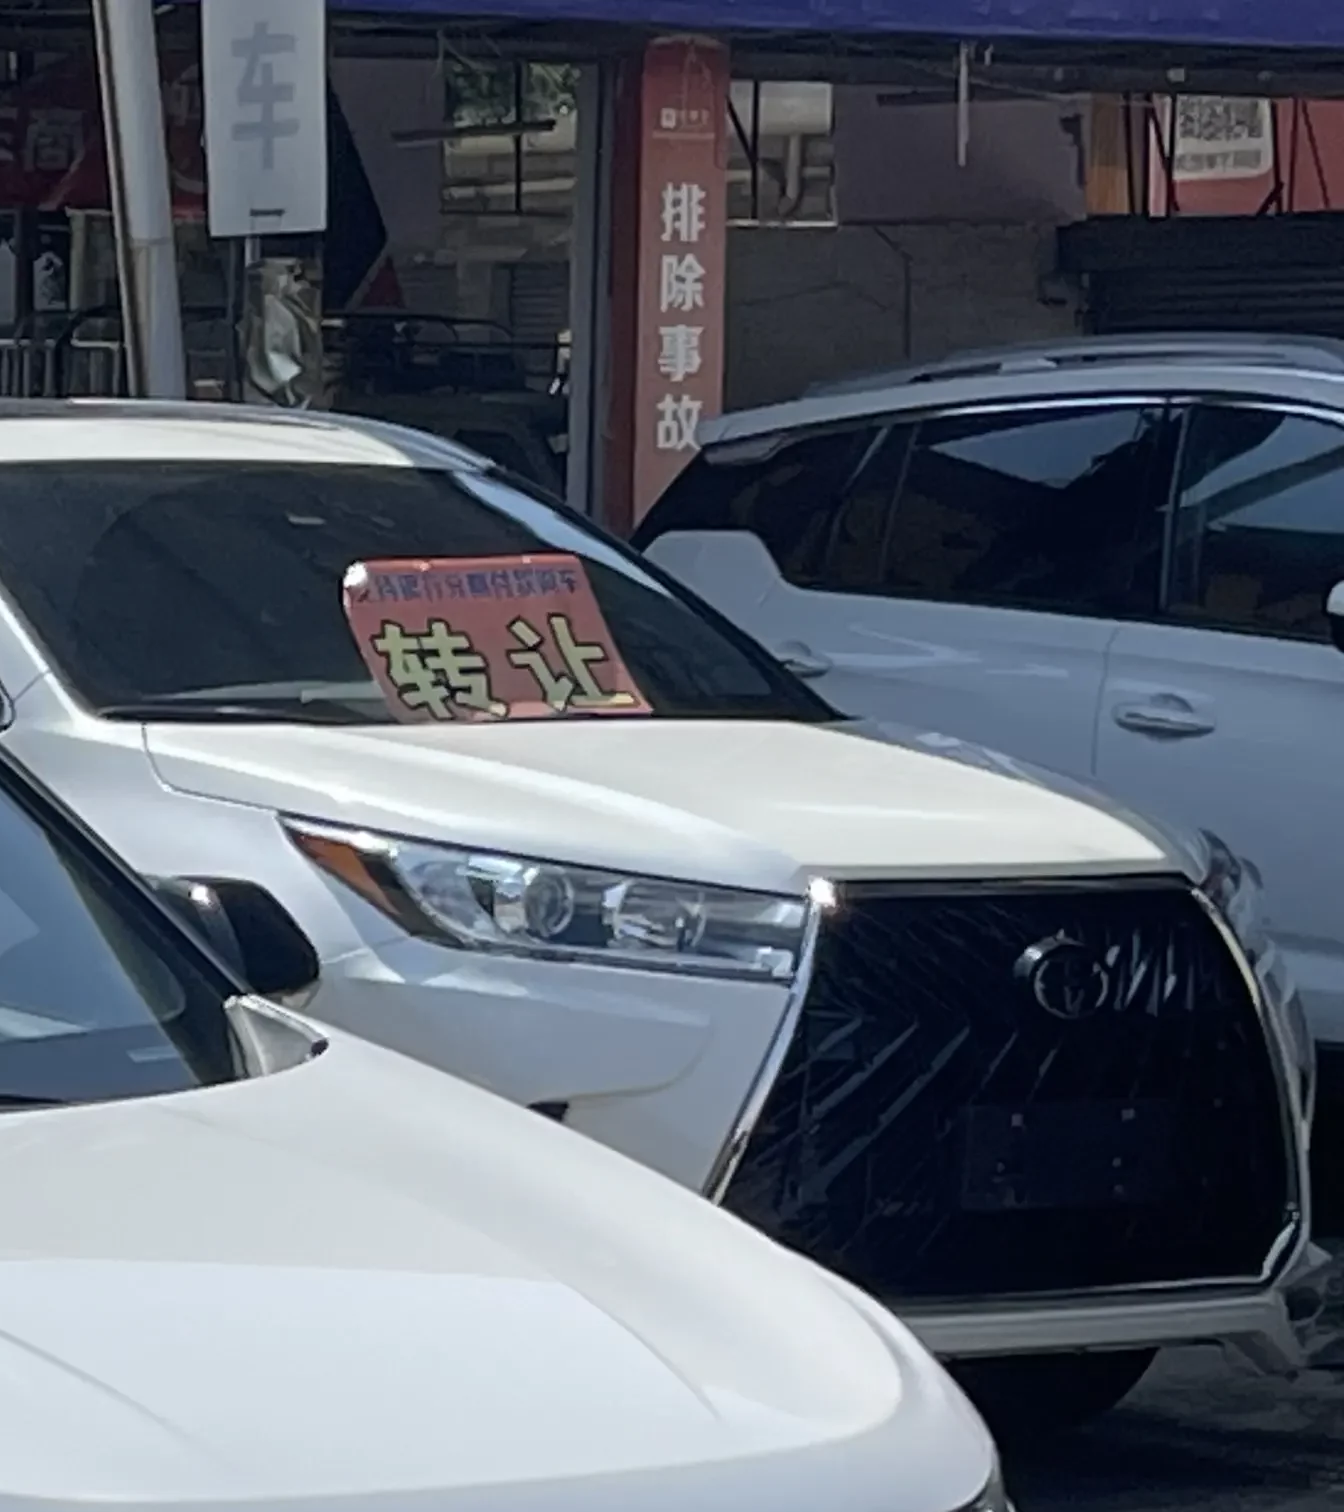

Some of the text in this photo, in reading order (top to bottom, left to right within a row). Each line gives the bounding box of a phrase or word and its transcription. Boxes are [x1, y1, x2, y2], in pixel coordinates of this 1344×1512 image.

[230, 20, 300, 170] 车
[656, 182, 706, 451] 排除事故
[370, 613, 639, 720] 转让
